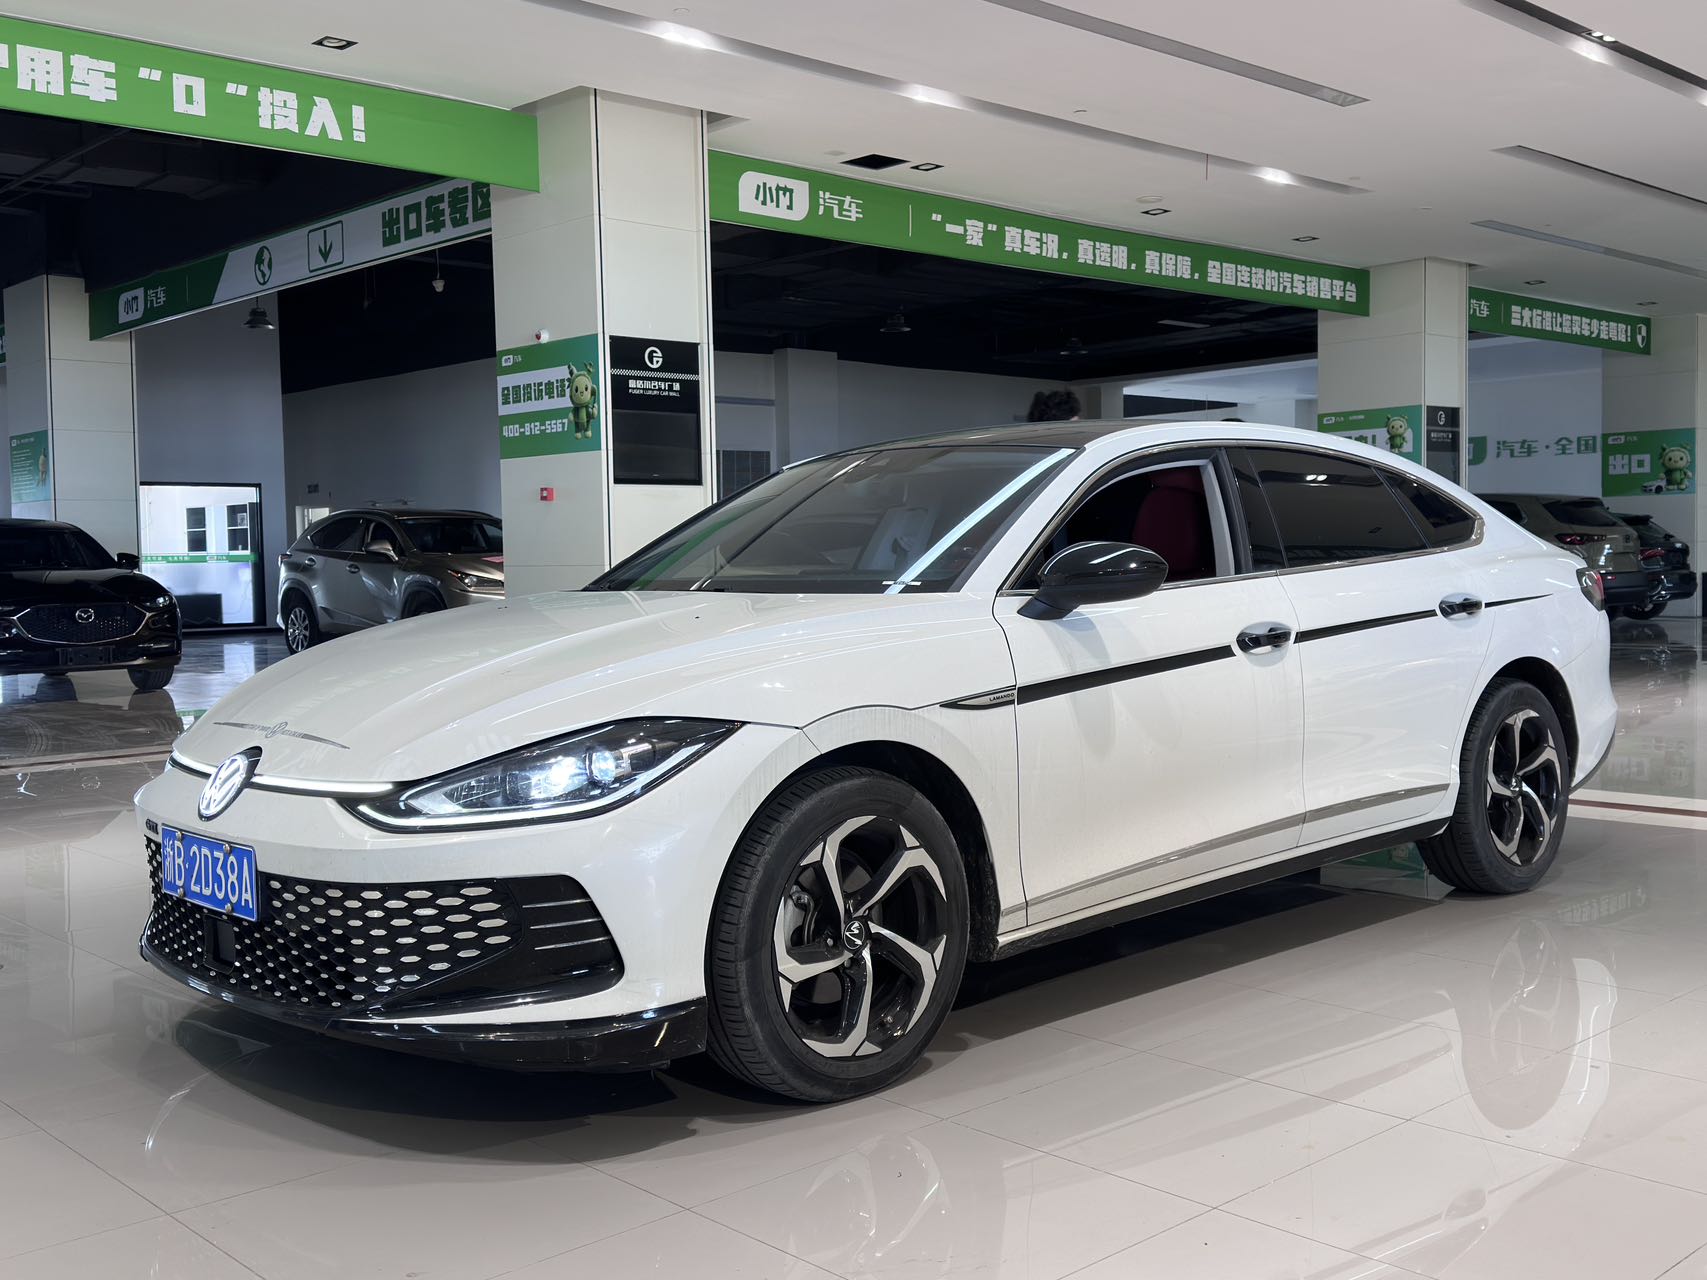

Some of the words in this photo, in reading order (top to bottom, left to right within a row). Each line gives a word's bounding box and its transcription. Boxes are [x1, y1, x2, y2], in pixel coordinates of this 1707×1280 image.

[0, 43, 366, 143] 用车“0”投入!
[381, 182, 493, 249] 出口车专区
[818, 190, 863, 222] 汽车
[502, 418, 569, 438] 400-812-5567
[1608, 453, 1651, 476] 出口
[988, 692, 1015, 702] LAMANDO
